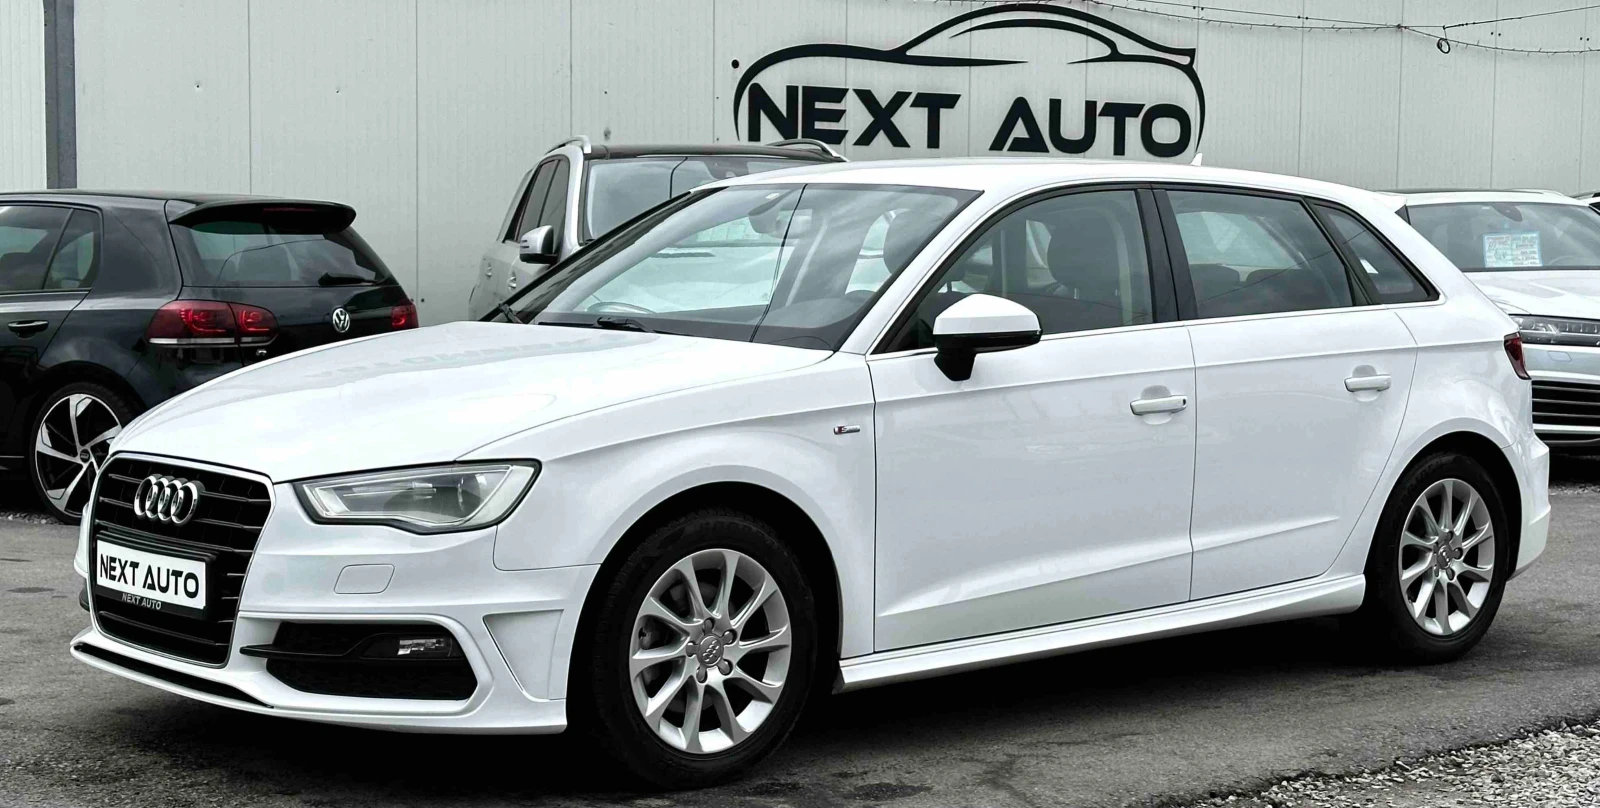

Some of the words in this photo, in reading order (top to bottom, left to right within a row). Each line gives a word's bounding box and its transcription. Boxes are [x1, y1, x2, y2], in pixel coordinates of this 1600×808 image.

[748, 82, 961, 149] NEXT
[988, 96, 1192, 158] AUTO
[100, 553, 139, 586] NEXT
[142, 564, 199, 599] AUTO
[122, 592, 140, 605] NEXT
[142, 597, 161, 610] AUTO
